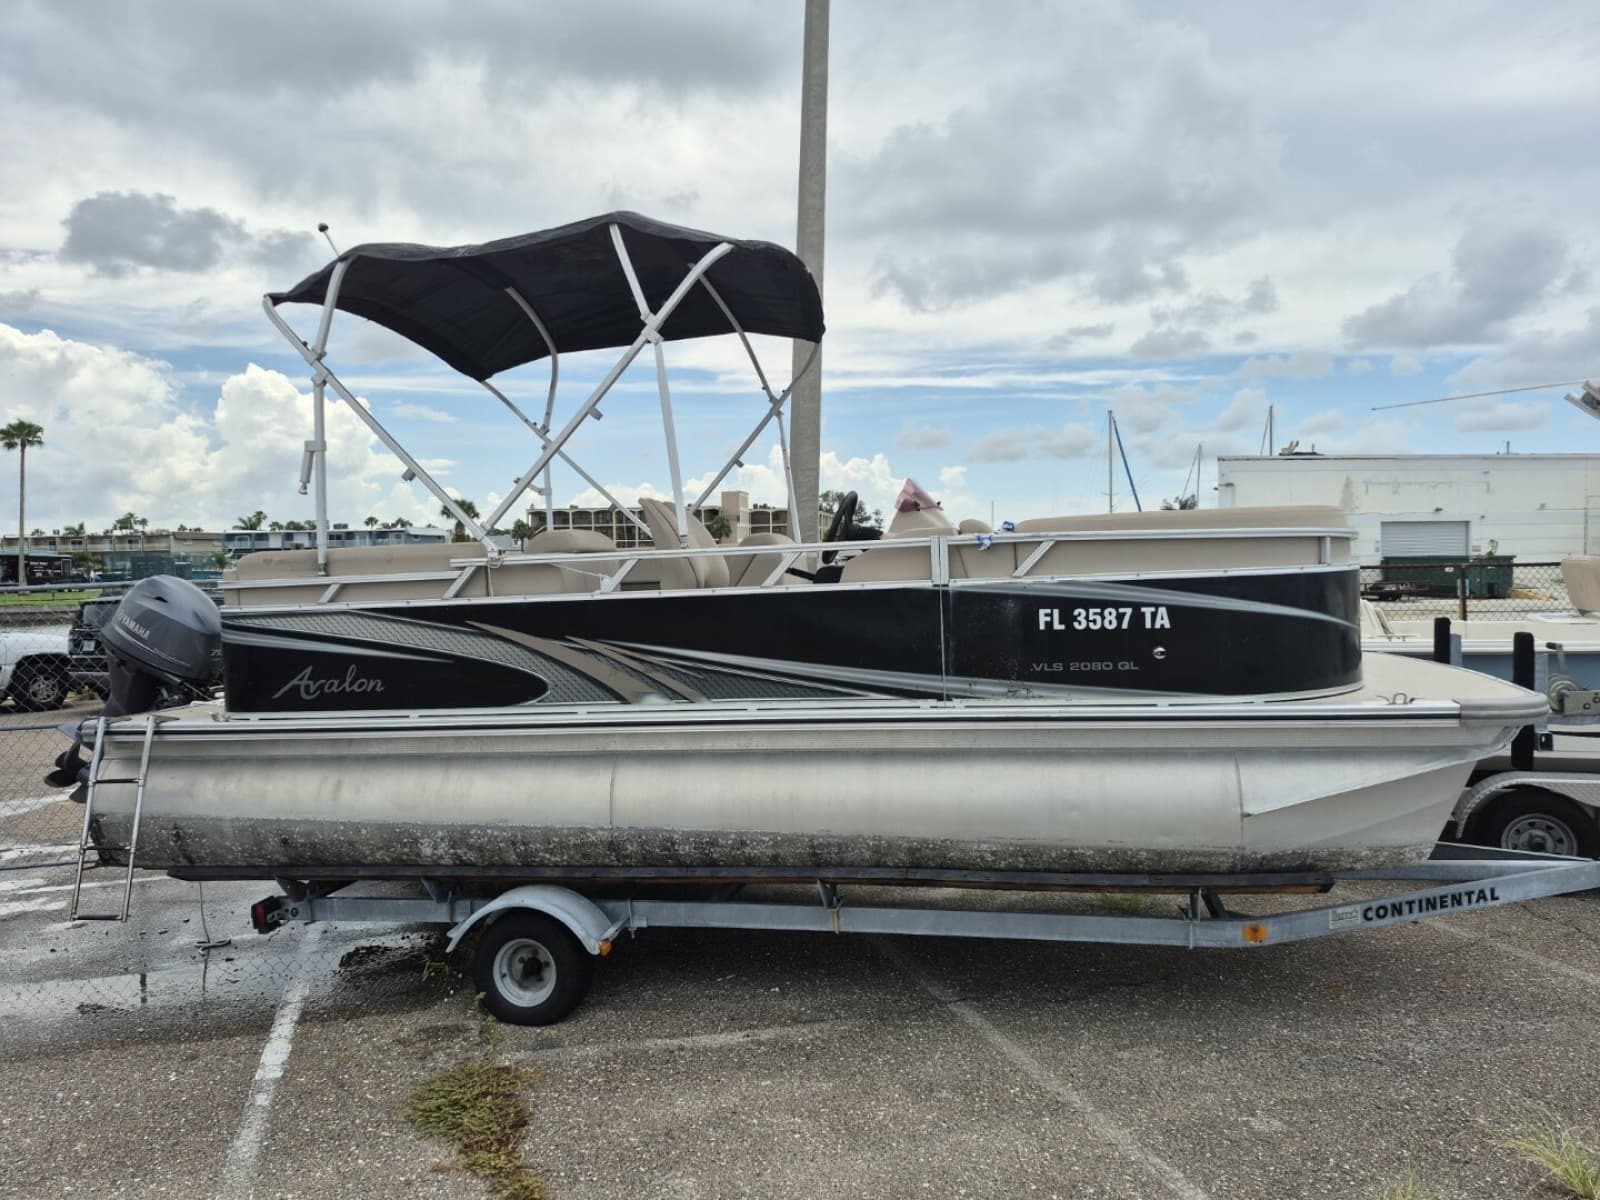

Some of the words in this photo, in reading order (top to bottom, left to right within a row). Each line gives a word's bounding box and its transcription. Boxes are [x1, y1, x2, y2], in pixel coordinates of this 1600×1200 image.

[120, 615, 151, 641] YAMAHA
[1038, 608, 1065, 630] FL
[1072, 607, 1133, 630] 3587
[1141, 606, 1171, 629] TA
[1032, 662, 1064, 672] VLS
[1069, 661, 1113, 671] 2080
[1118, 661, 1140, 670] GL
[271, 664, 386, 701] Avalon
[1363, 887, 1500, 921] CONTINENTAL
